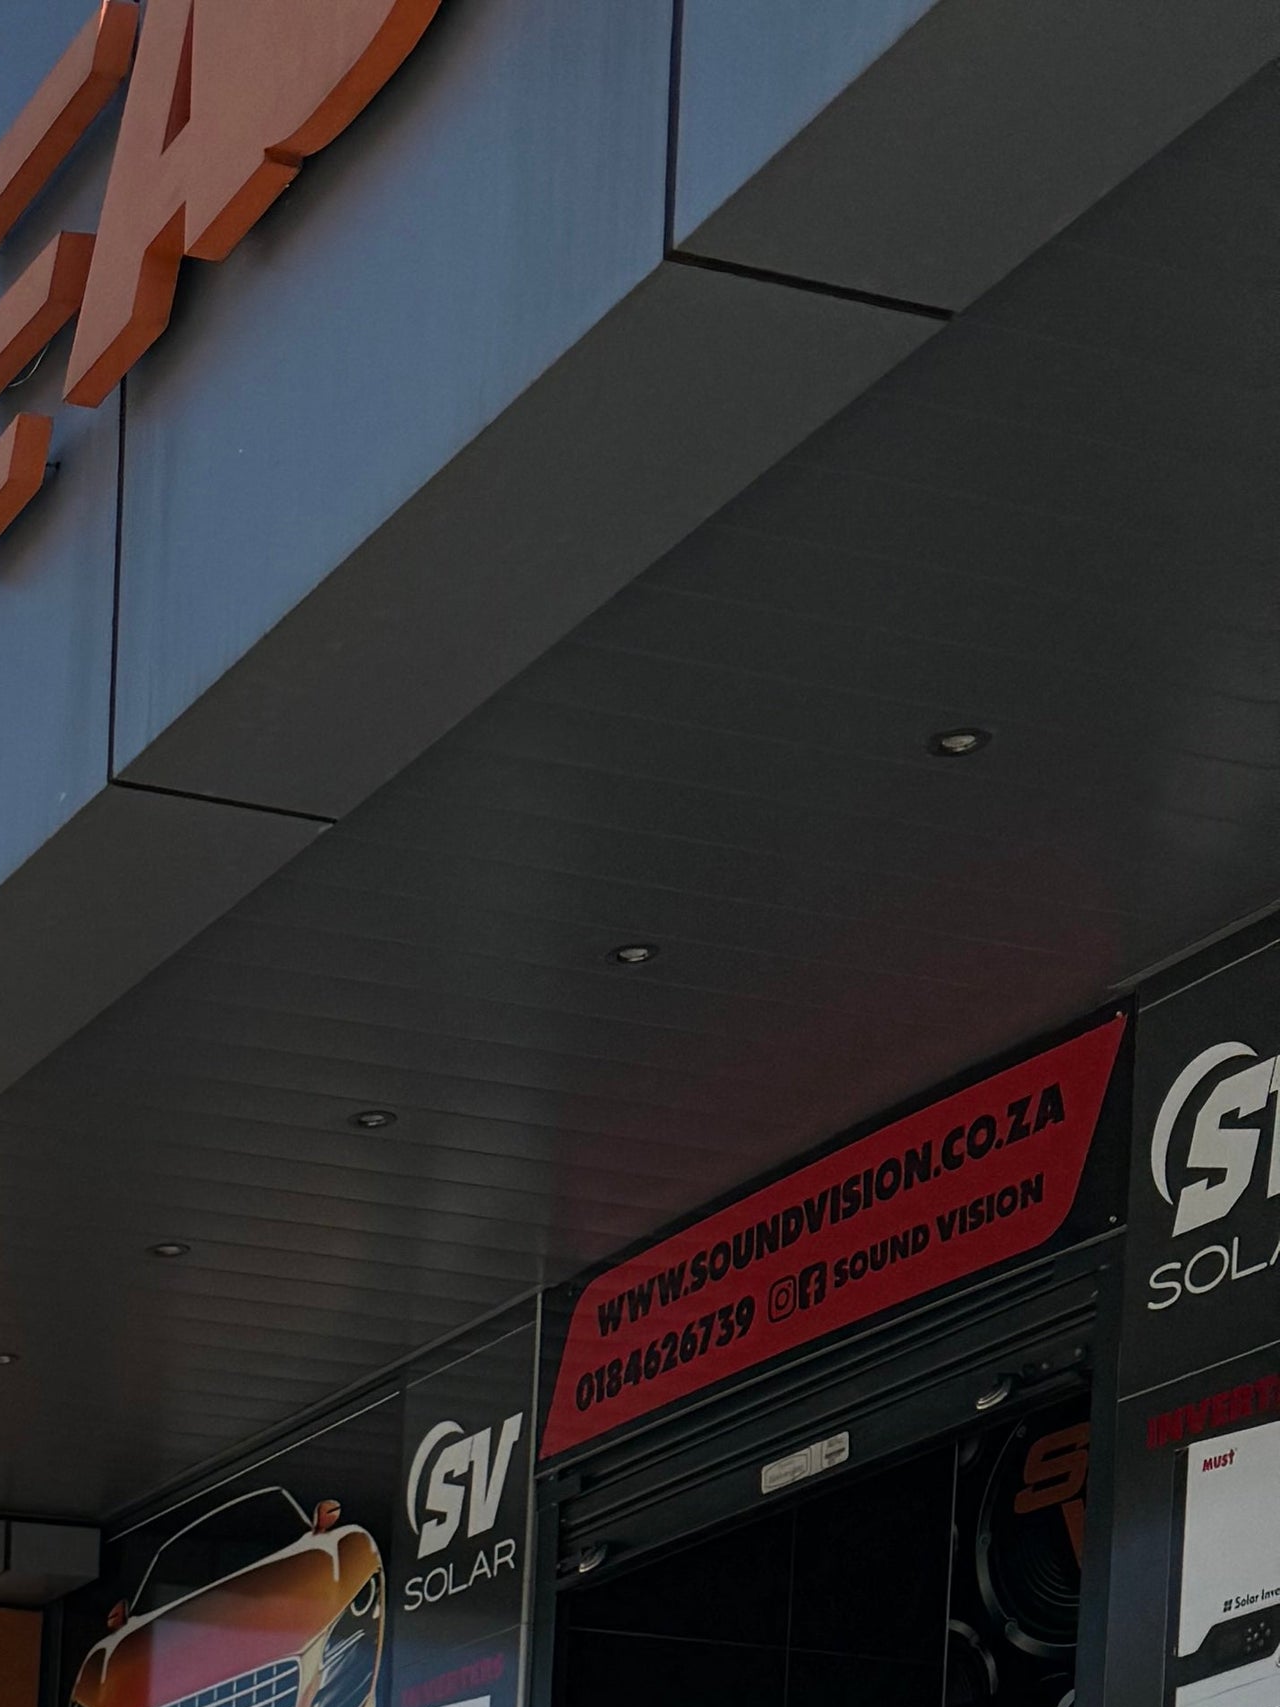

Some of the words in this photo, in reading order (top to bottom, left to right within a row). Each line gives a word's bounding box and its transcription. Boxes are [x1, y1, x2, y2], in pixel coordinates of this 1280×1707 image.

[575, 1295, 755, 1411] 0184626739
[832, 1223, 929, 1289] SOUND
[935, 1172, 1044, 1243] VISION
[597, 1082, 1066, 1337] WWW.SOUNDVISION.CO.ZA
[404, 1537, 517, 1612] SOLAR
[416, 1411, 524, 1560] SV
